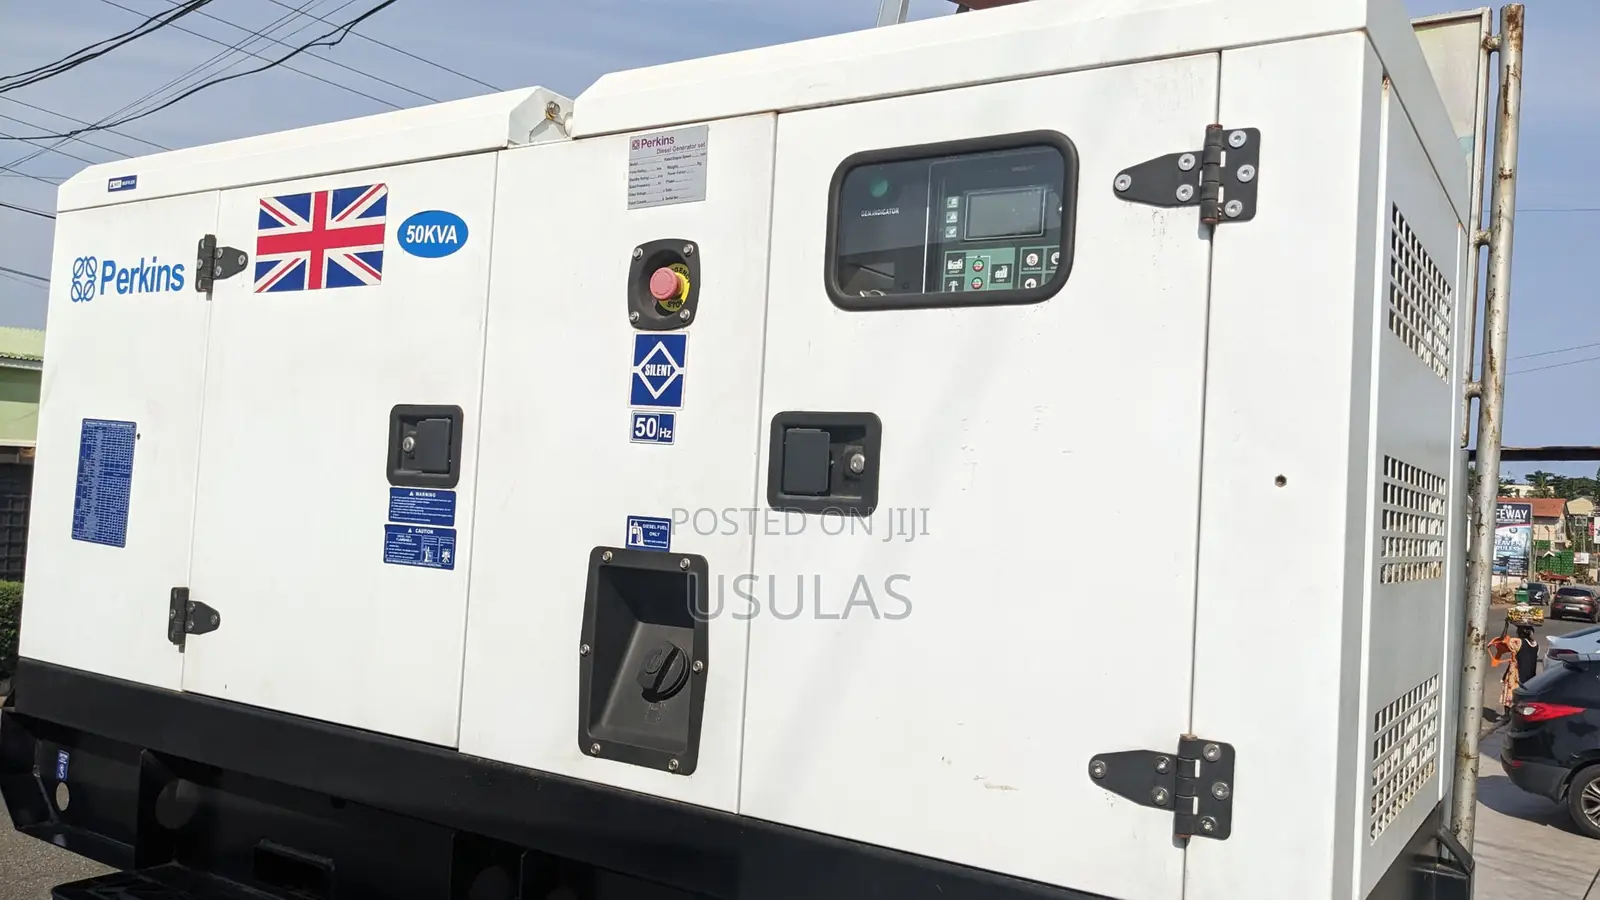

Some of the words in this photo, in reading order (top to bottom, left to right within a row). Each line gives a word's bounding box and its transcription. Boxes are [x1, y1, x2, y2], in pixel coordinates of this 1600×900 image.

[641, 136, 675, 149] Perkins
[656, 147, 672, 155] Diesel
[672, 144, 697, 153] Generator
[405, 223, 458, 246] 50KVA
[100, 255, 185, 296] Perkins
[667, 299, 684, 309] STOP
[644, 363, 672, 377] SILENT
[634, 416, 657, 439] 50
[660, 427, 672, 440] Hz
[1496, 508, 1528, 519] FEWAY
